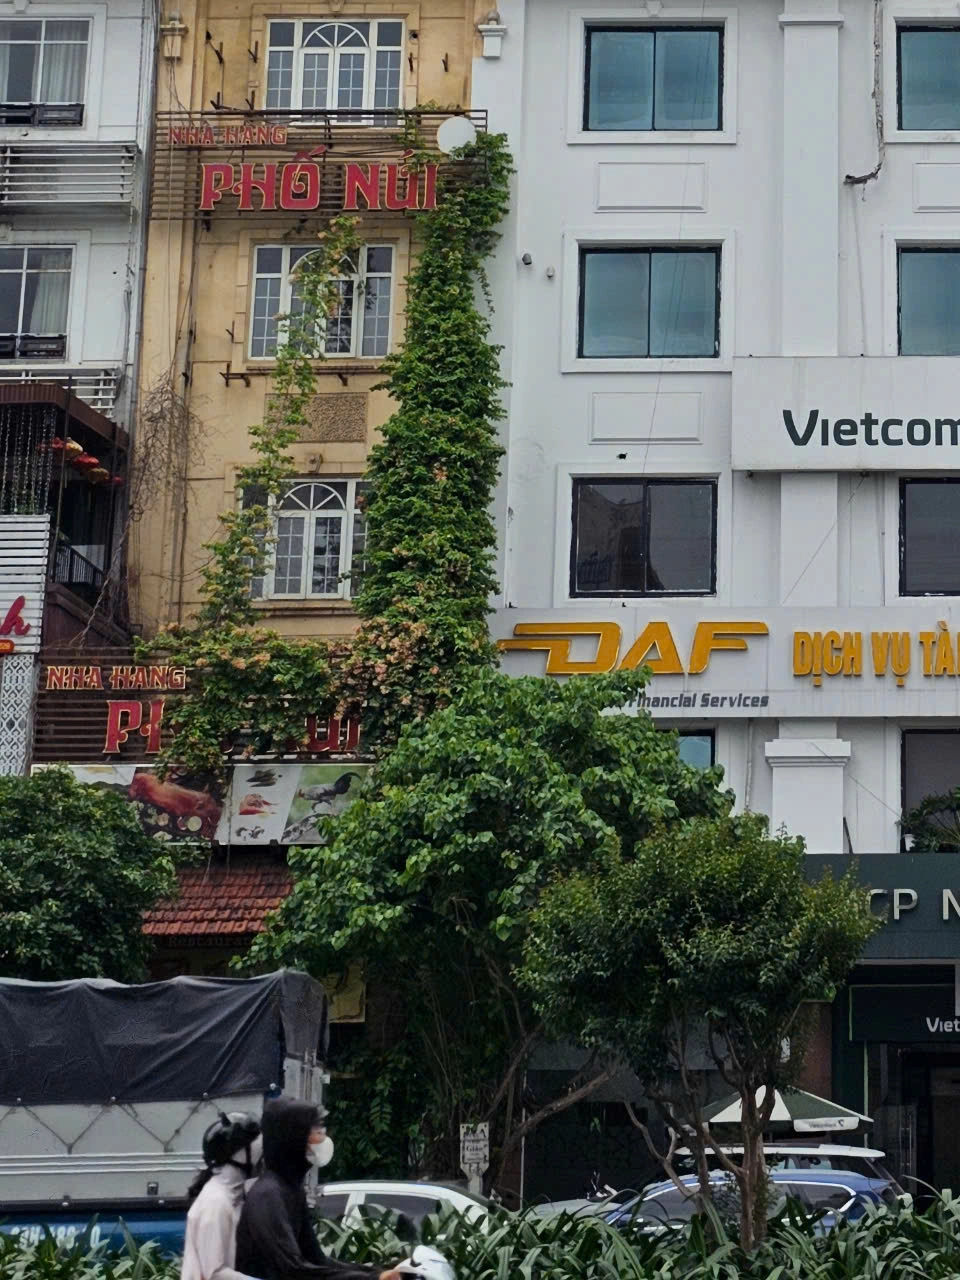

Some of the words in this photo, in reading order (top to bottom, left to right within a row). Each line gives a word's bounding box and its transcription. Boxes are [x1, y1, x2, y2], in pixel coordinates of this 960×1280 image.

[199, 144, 328, 210] PHỐ
[343, 149, 440, 210] NÚI
[497, 621, 769, 675] DAF
[793, 630, 863, 687] DỊCH
[871, 631, 911, 687] VỤ
[700, 692, 770, 708] Services
[867, 888, 919, 920] CP
